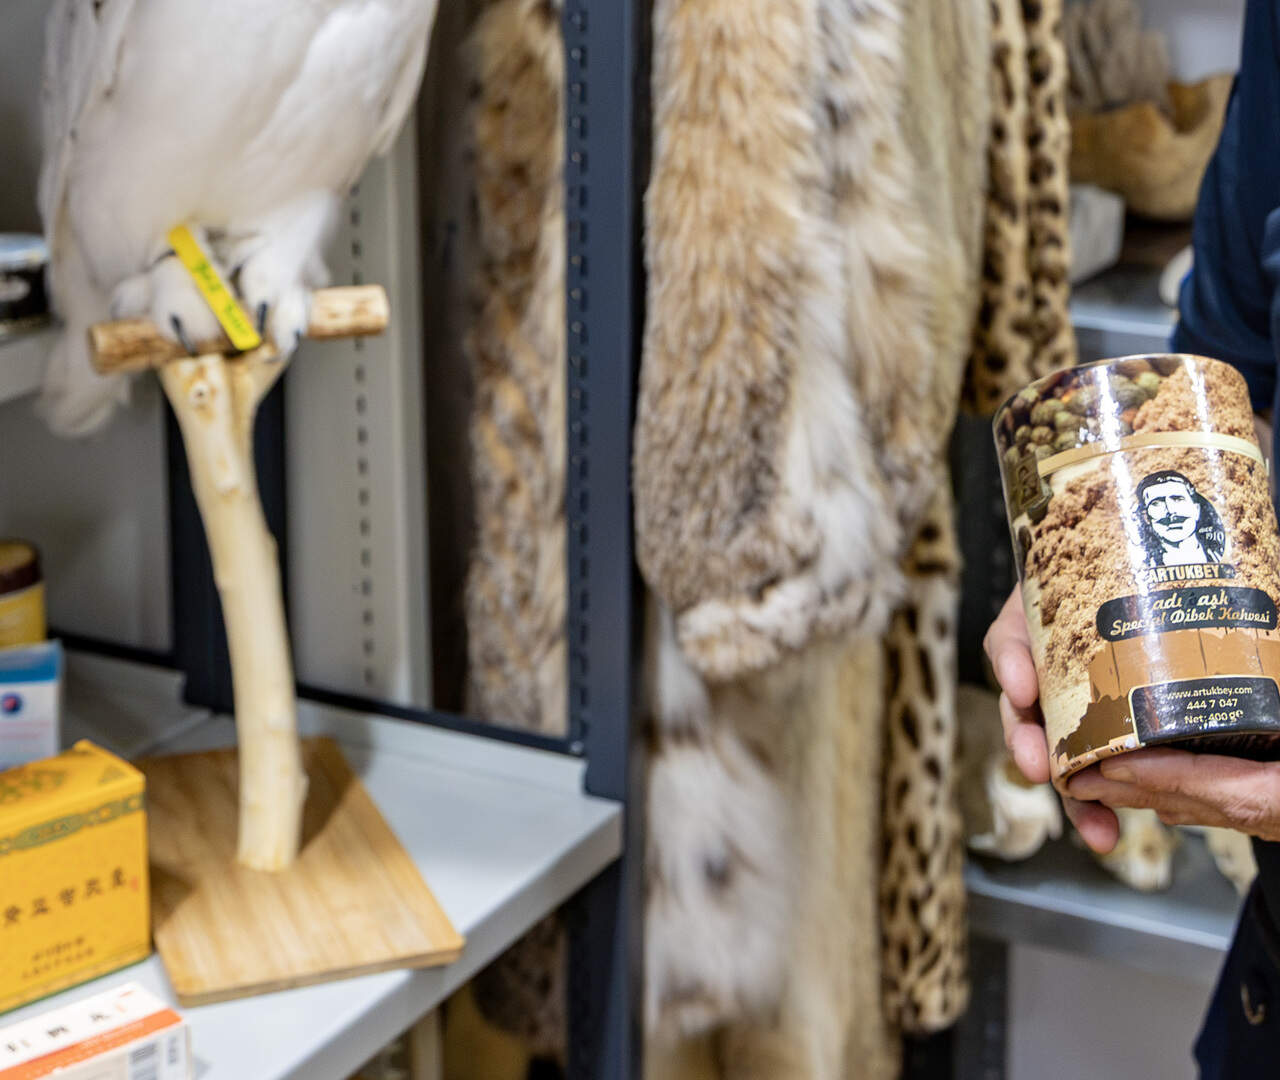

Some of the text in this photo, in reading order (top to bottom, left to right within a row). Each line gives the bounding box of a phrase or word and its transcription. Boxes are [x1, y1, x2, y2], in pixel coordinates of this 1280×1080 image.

[1149, 565, 1221, 583] ARTUKBEY
[1110, 607, 1271, 636] Specal Dibek Kahvesi
[1186, 697, 1238, 710] 444 7 047
